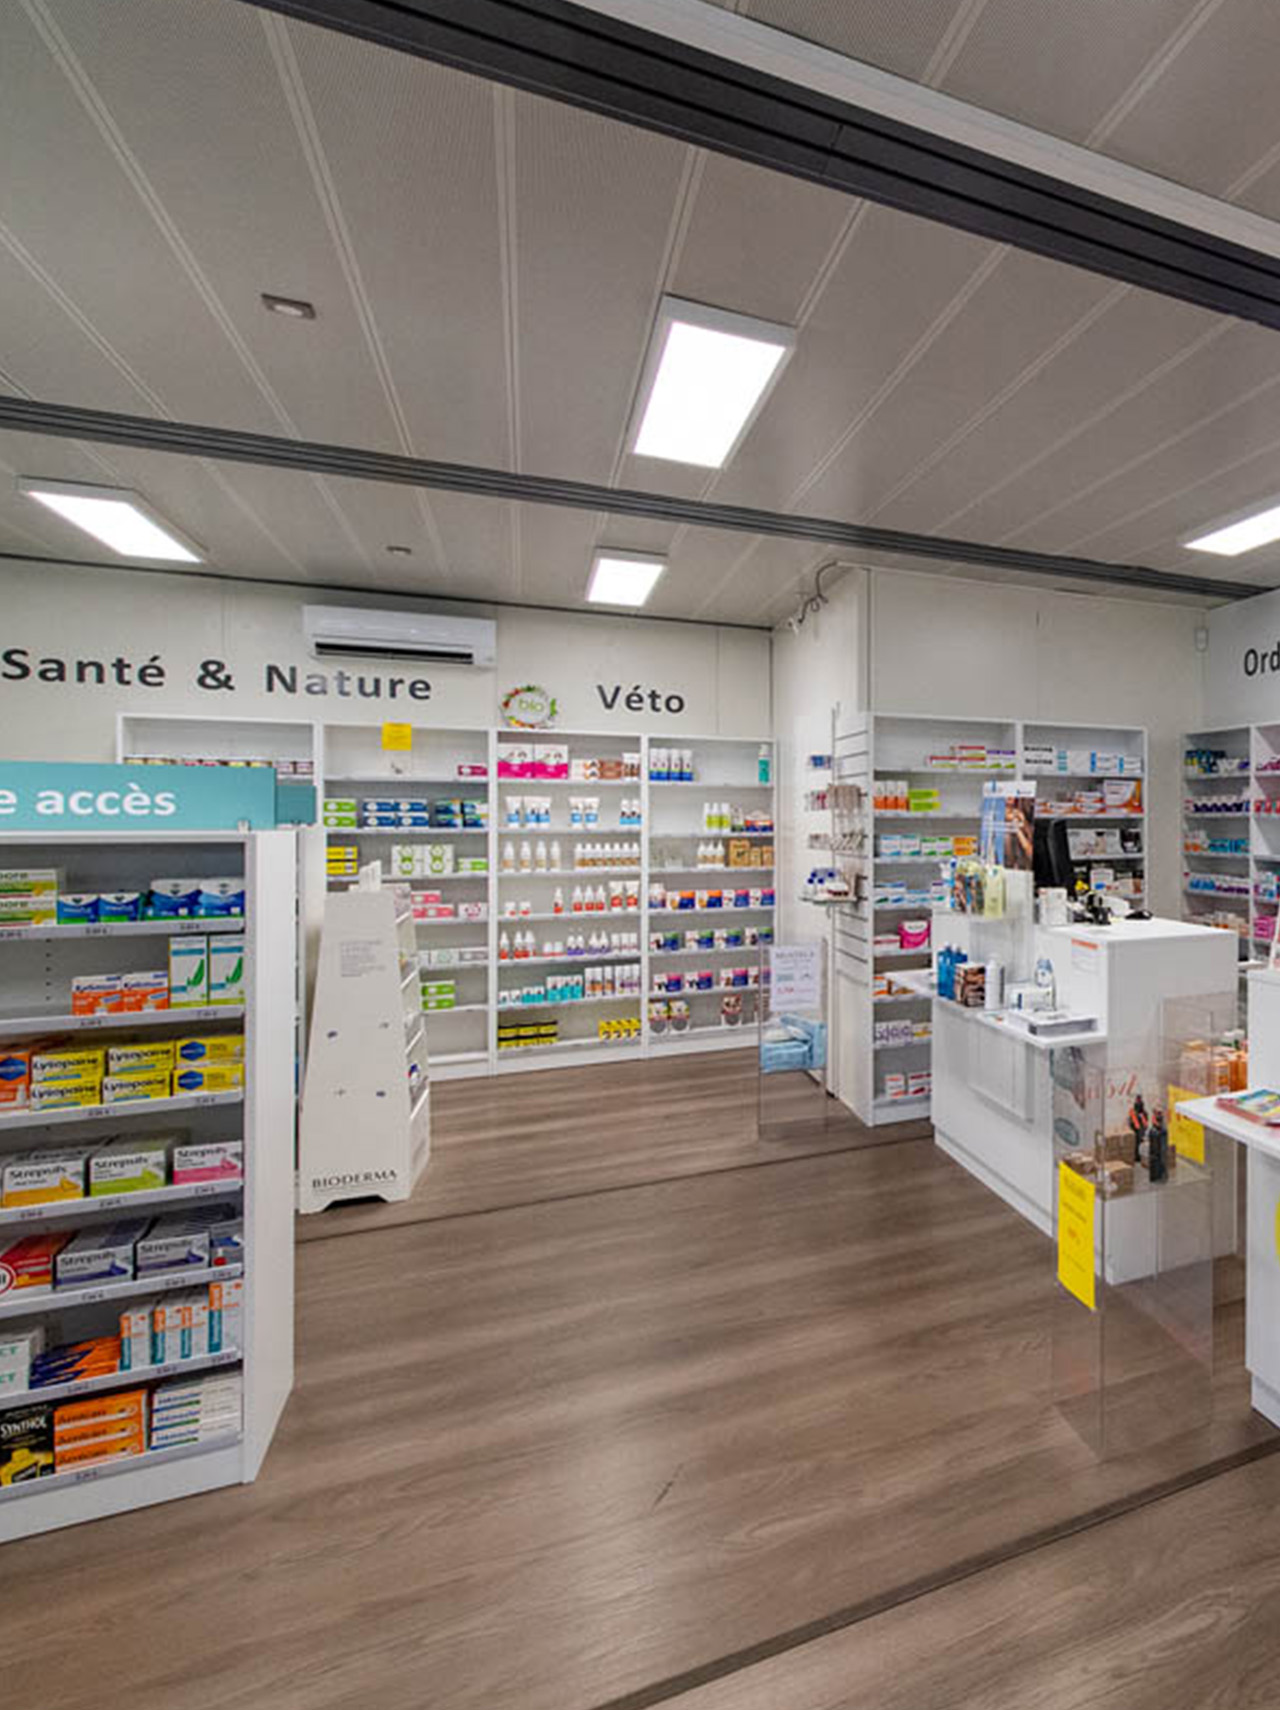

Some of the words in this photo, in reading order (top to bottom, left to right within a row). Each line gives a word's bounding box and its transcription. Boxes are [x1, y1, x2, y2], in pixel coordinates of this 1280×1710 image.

[1, 649, 165, 687] Santé
[197, 660, 235, 691] &
[266, 664, 432, 700] Nature
[597, 685, 685, 714] Véto
[35, 783, 177, 816] accès
[312, 1168, 398, 1189] BIODERMA
